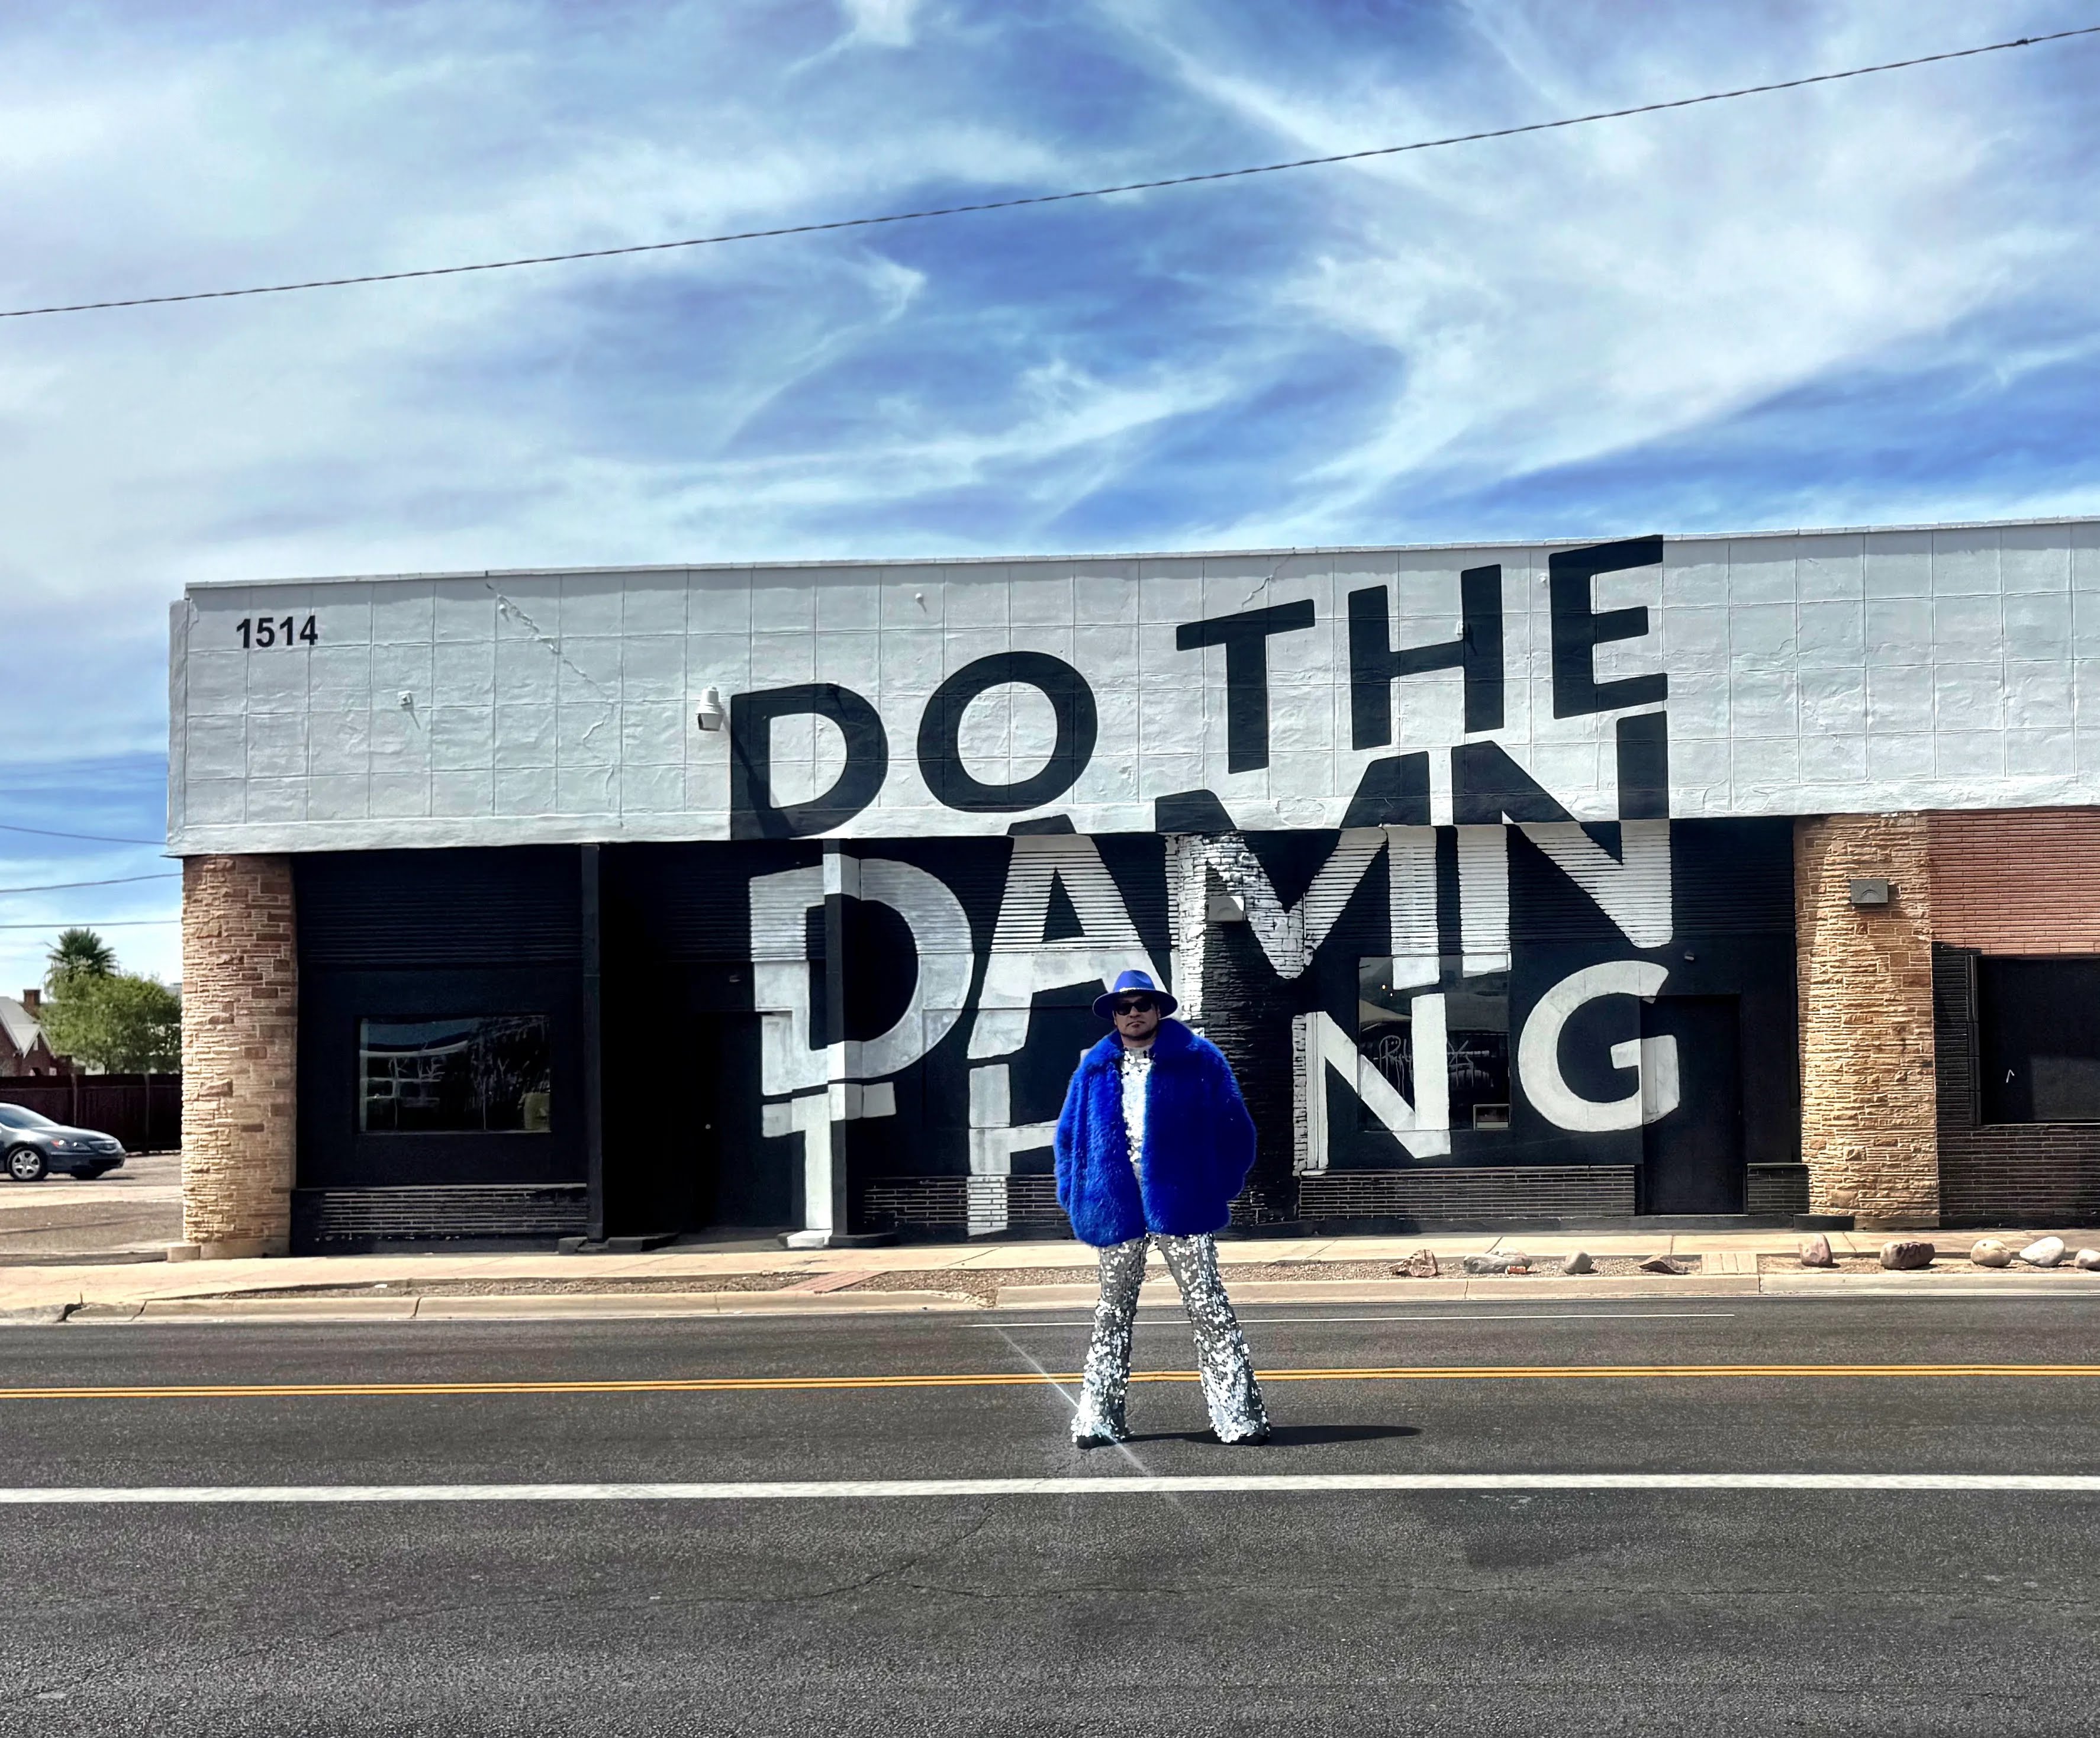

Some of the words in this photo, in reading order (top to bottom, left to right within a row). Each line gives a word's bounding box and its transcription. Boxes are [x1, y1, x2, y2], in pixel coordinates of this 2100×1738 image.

[236, 615, 318, 649] 1514
[730, 650, 1097, 840] DO
[1177, 535, 1668, 774] THE
[749, 710, 1673, 1096] DAMN
[762, 960, 1679, 1247] THNG
